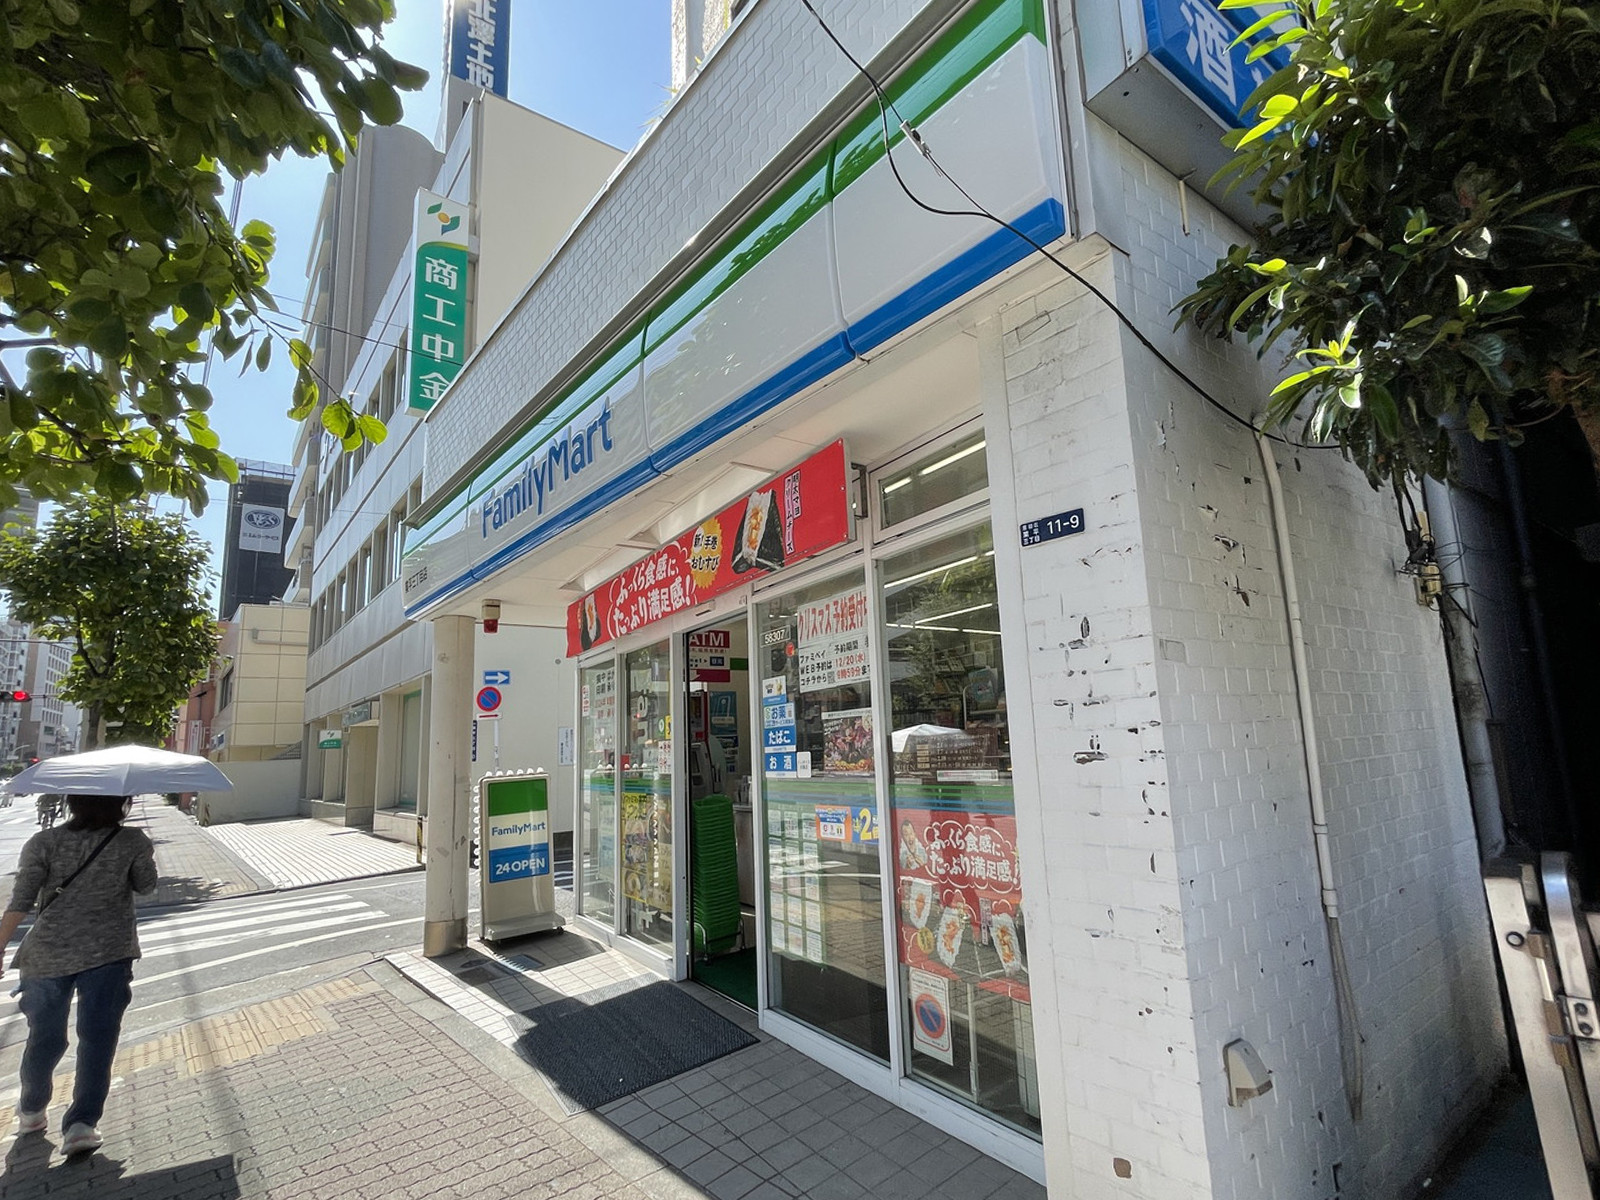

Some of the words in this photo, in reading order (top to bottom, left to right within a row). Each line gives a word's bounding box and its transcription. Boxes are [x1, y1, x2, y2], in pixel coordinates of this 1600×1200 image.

[418, 256, 459, 401] 商工中金
[482, 396, 614, 538] FamilyMart
[1046, 514, 1080, 535] 11-9
[691, 555, 719, 571] おむすび
[611, 575, 692, 638] たっぷり満足感!
[689, 632, 725, 647] ATM
[764, 629, 786, 645] 58307
[768, 730, 791, 745] たばこ
[491, 820, 547, 837] FamilyMart
